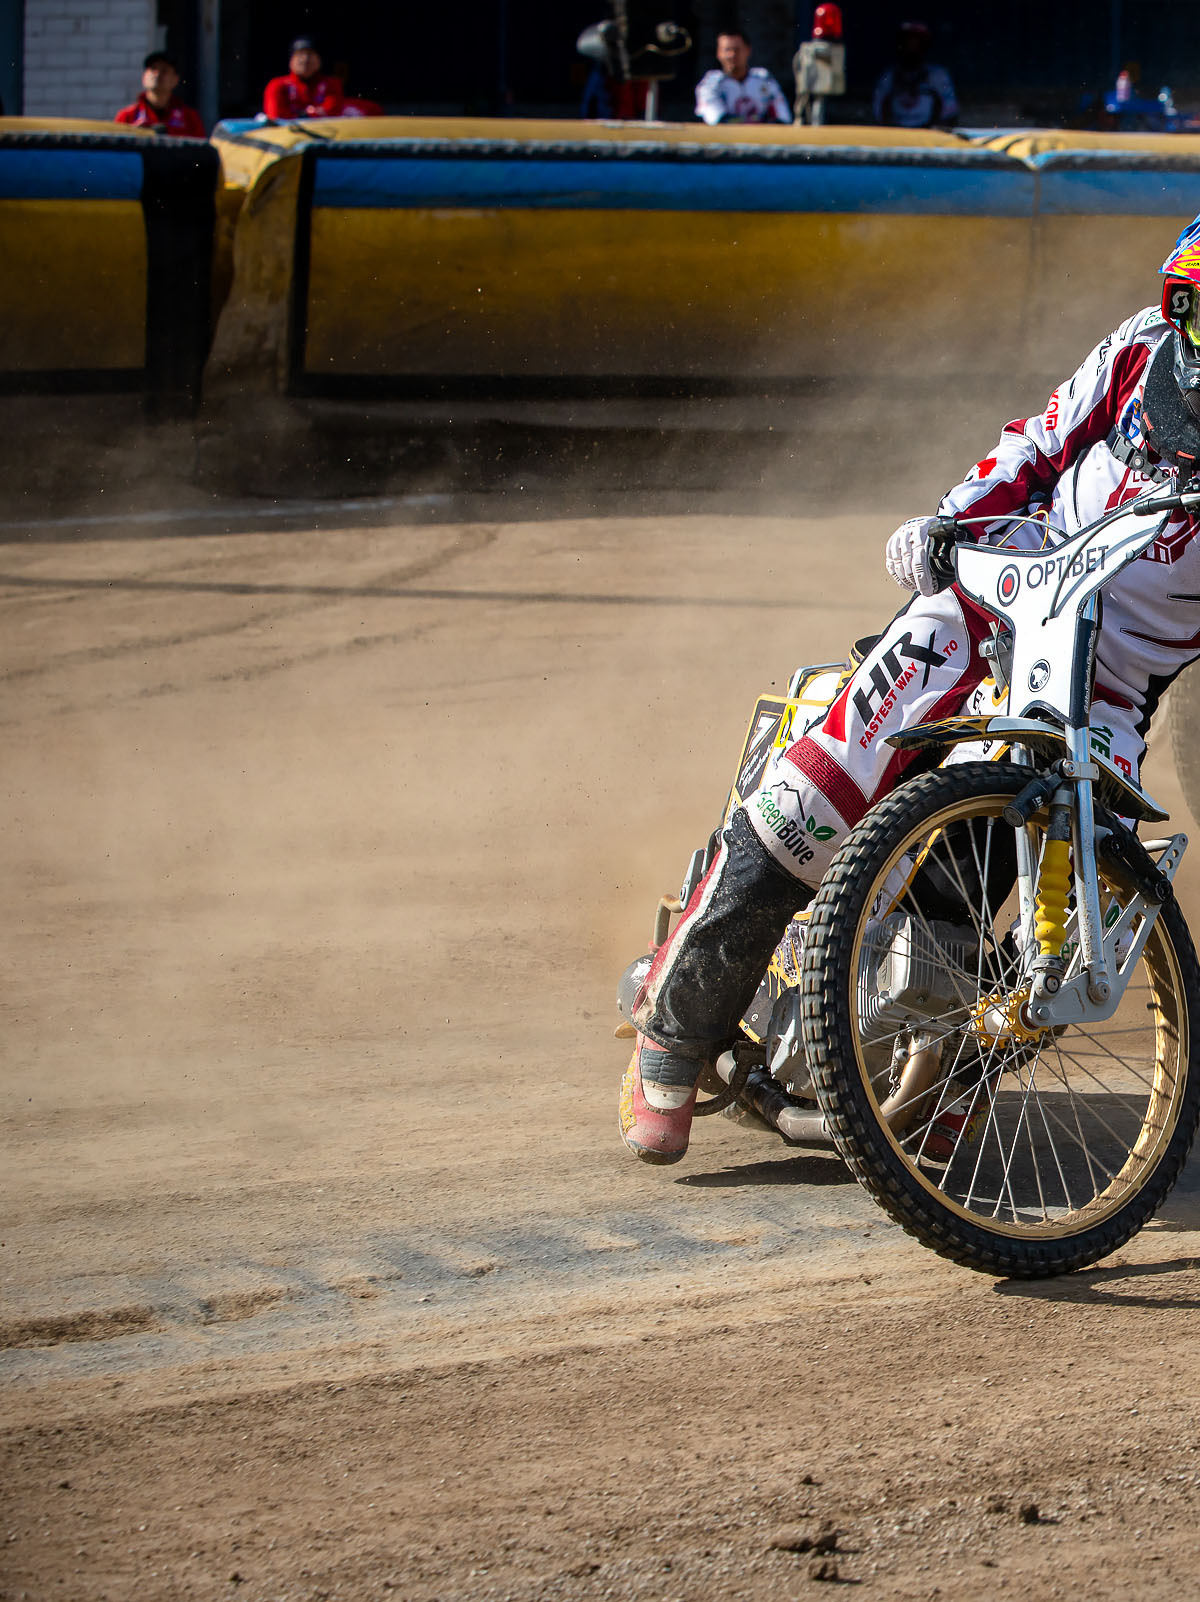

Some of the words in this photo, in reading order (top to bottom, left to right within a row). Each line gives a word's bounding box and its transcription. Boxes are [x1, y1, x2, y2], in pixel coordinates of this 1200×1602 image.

[1026, 544, 1110, 589] OPTIBET
[858, 688, 899, 750] FASTEST
[894, 661, 919, 692] WAY
[942, 639, 959, 658] TO
